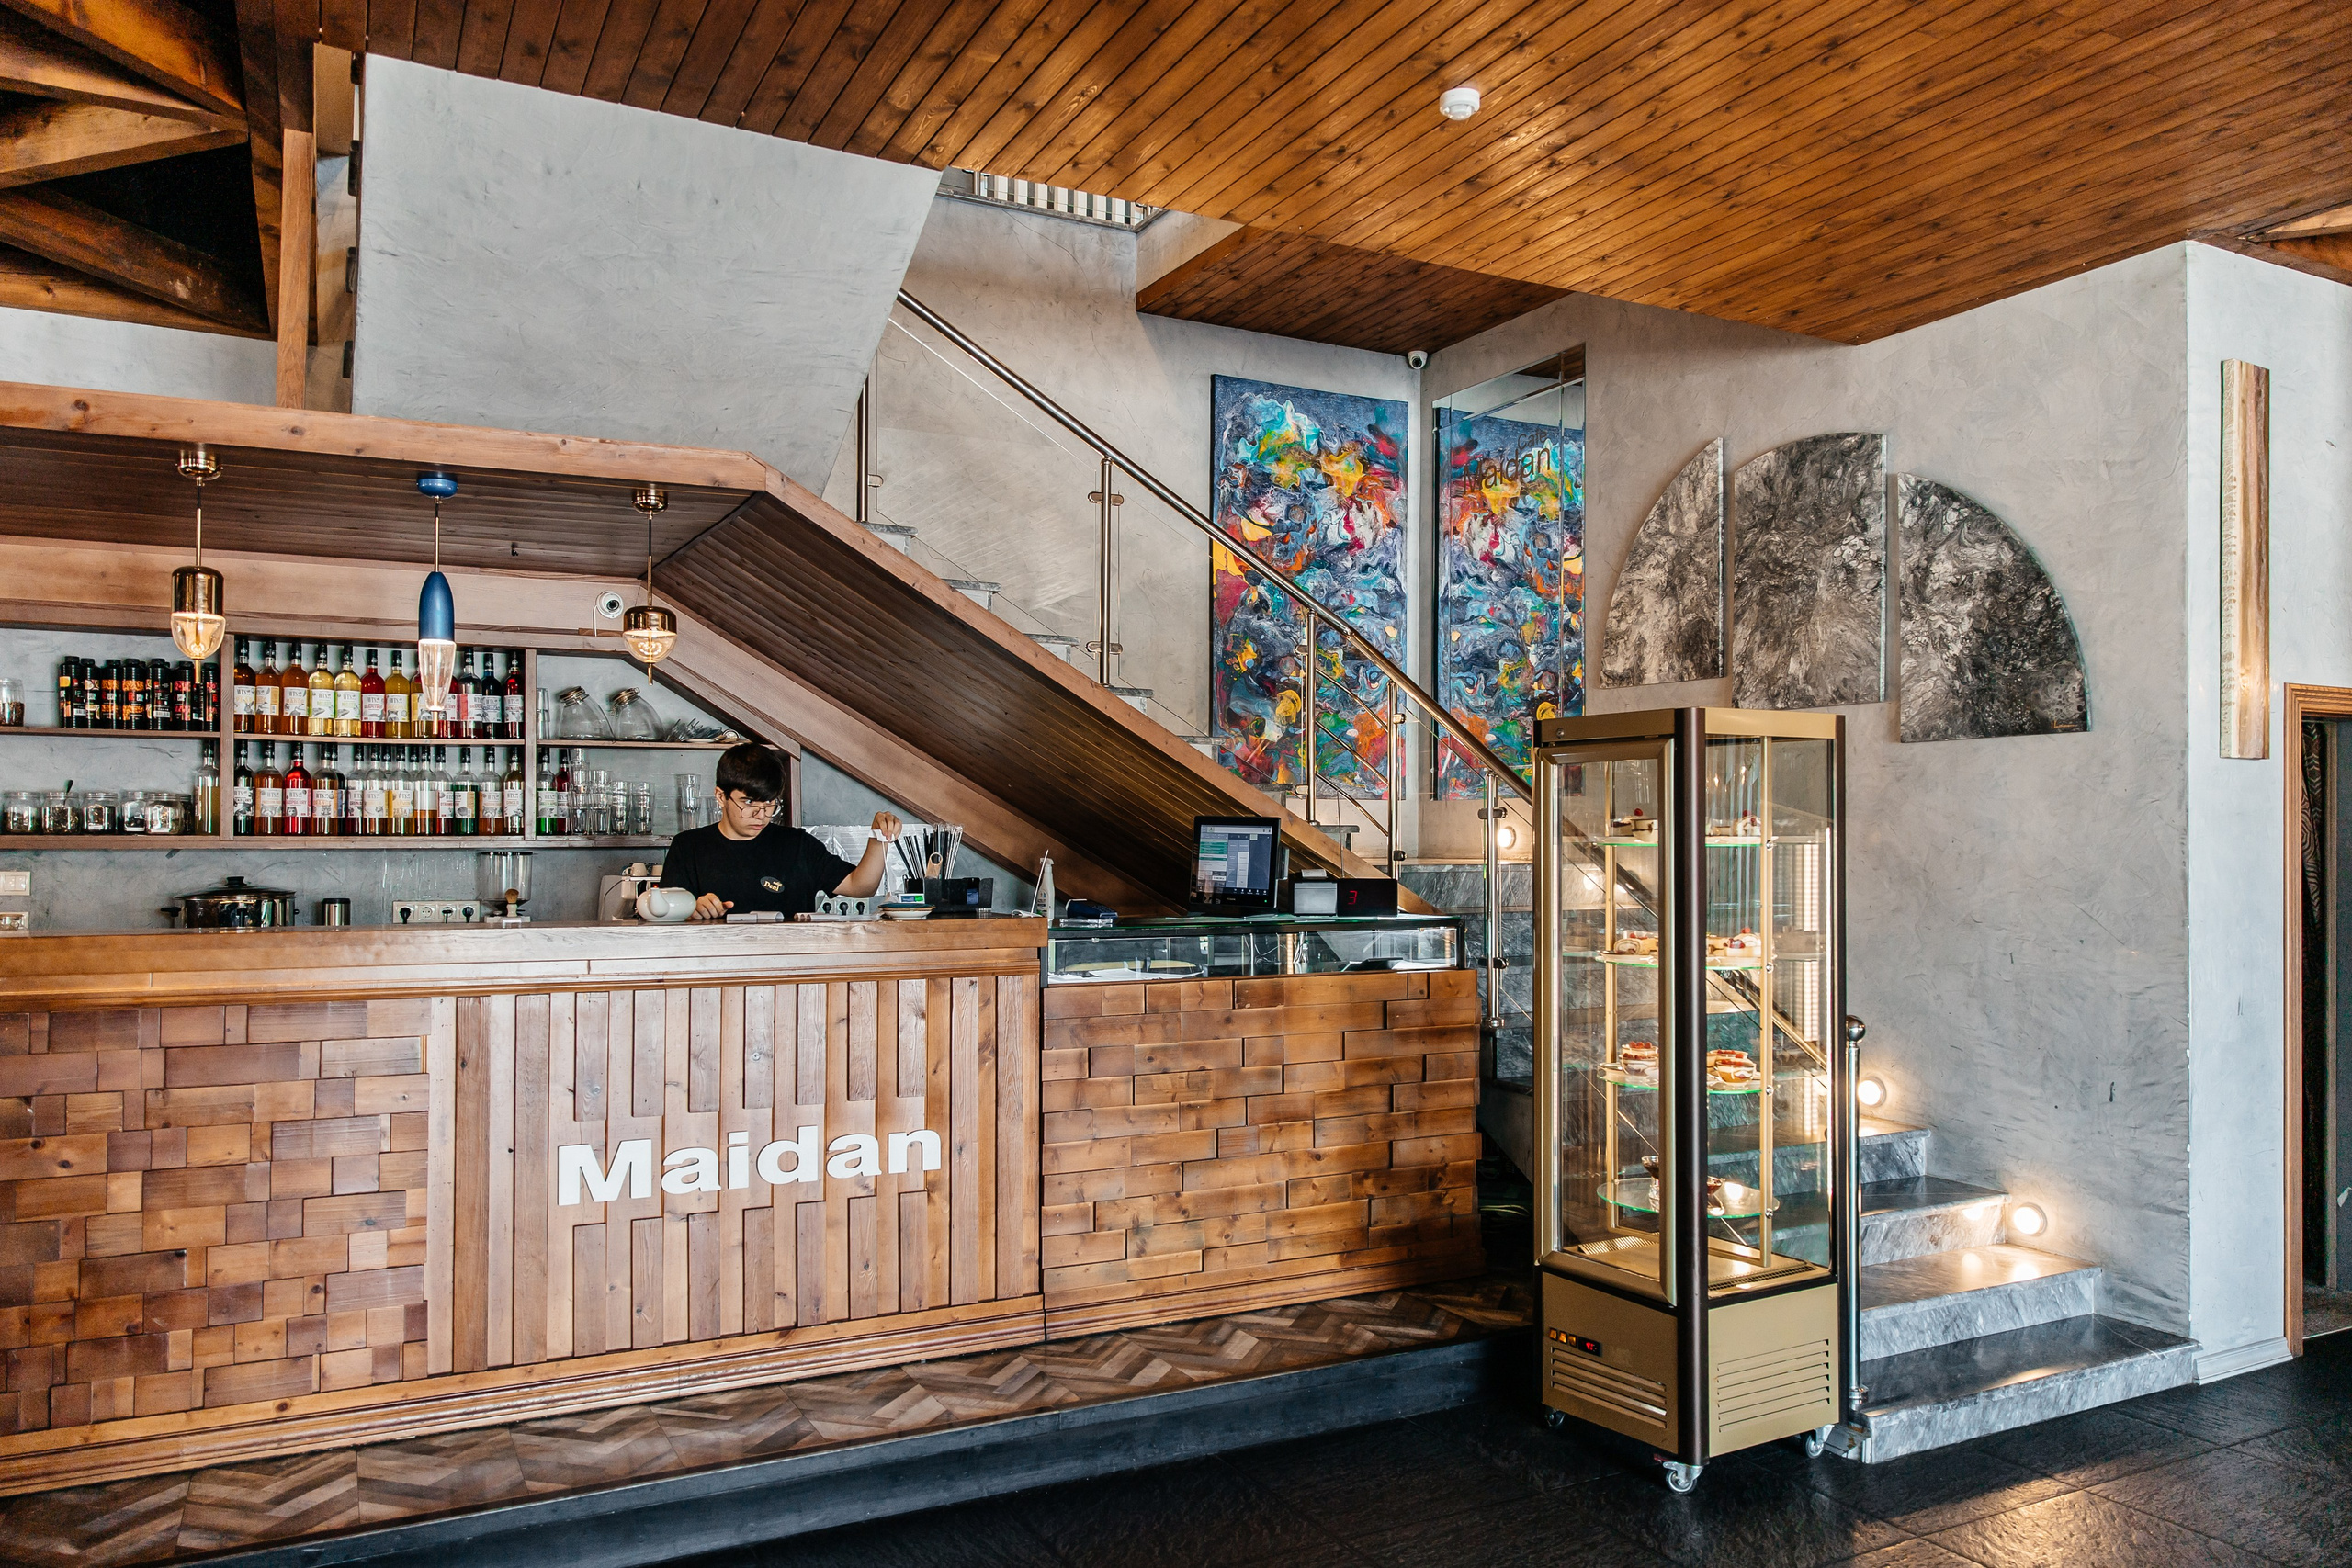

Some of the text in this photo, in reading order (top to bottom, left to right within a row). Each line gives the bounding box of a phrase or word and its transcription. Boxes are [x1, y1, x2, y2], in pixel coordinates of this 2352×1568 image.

[1517, 428, 1548, 450] Cafe
[1463, 447, 1551, 494] Maidan
[1347, 890, 1358, 905] 3
[558, 1125, 942, 1206] Maidan
